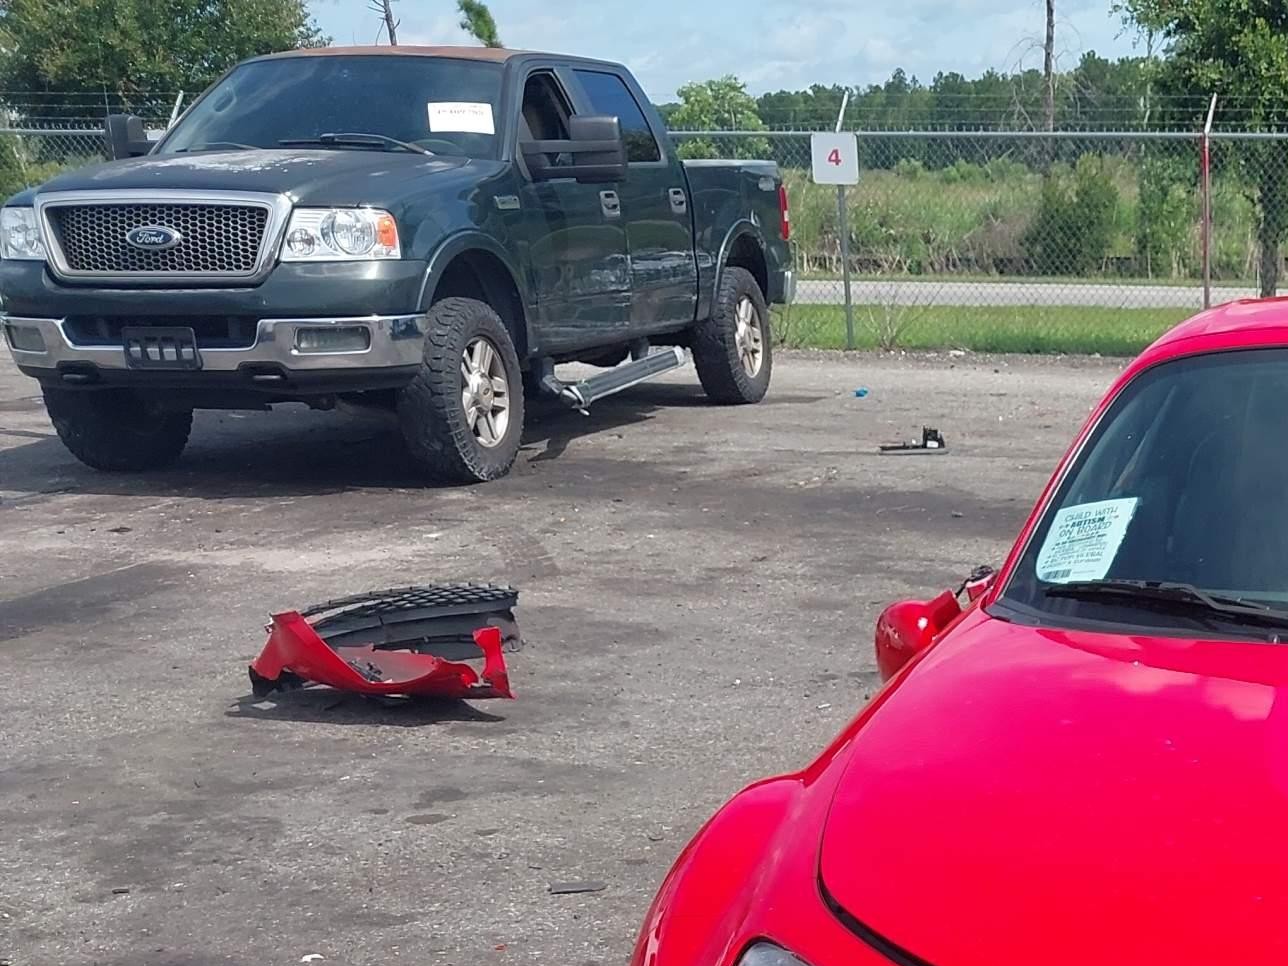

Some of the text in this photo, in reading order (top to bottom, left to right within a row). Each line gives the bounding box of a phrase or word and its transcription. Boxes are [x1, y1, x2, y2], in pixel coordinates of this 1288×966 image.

[828, 149, 842, 166] 4
[137, 231, 165, 244] Ford
[1065, 505, 1119, 522] CHILD WITH
[1070, 516, 1106, 528] AUTISM
[1059, 528, 1074, 538] ON
[1077, 521, 1112, 535] BOARD
